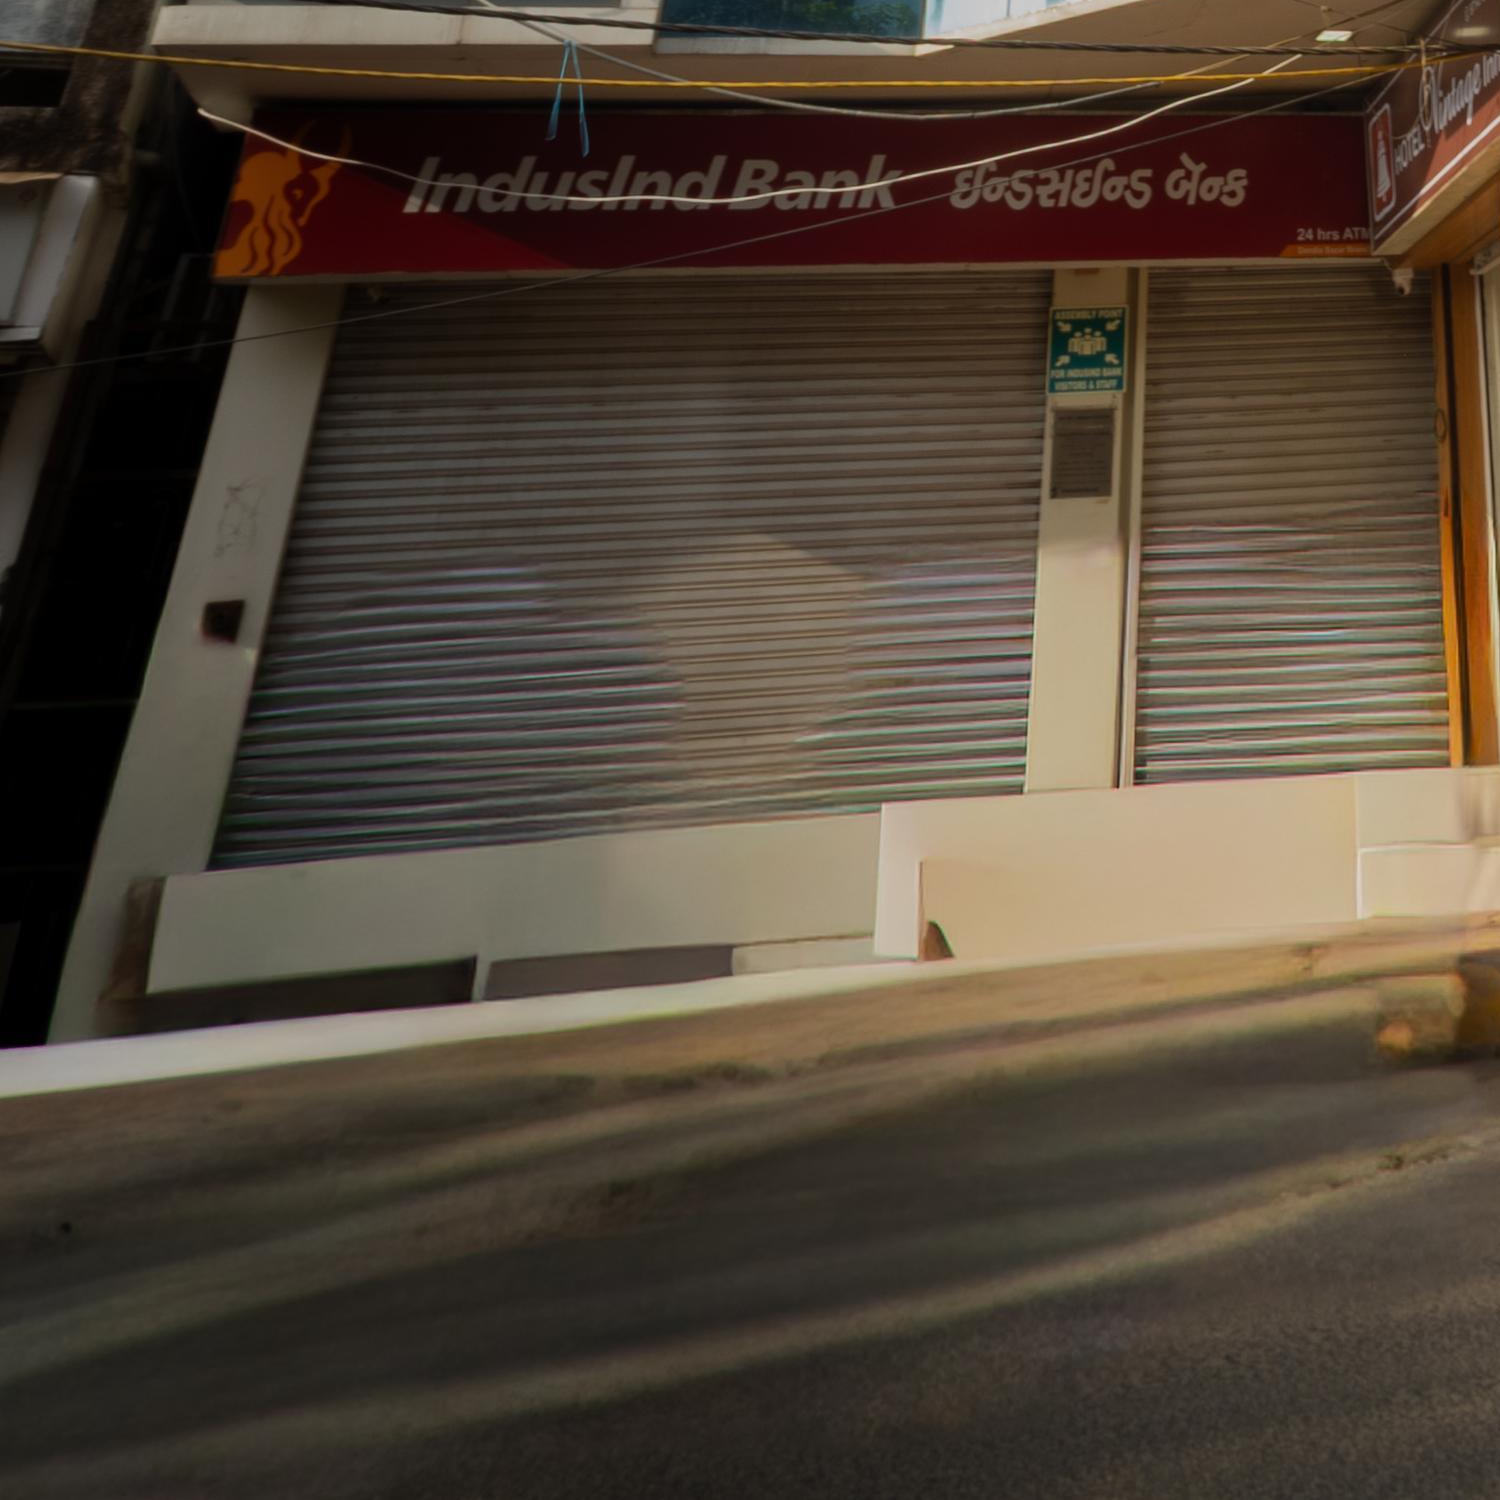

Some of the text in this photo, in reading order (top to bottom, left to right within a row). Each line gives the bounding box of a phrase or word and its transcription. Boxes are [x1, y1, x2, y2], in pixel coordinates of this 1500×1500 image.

[1393, 127, 1425, 176] HOTEL
[1419, 53, 1481, 134] Vintage
[402, 154, 904, 214] IndusInd Bank
[1296, 228, 1314, 241] 24
[1317, 227, 1340, 241] hrs
